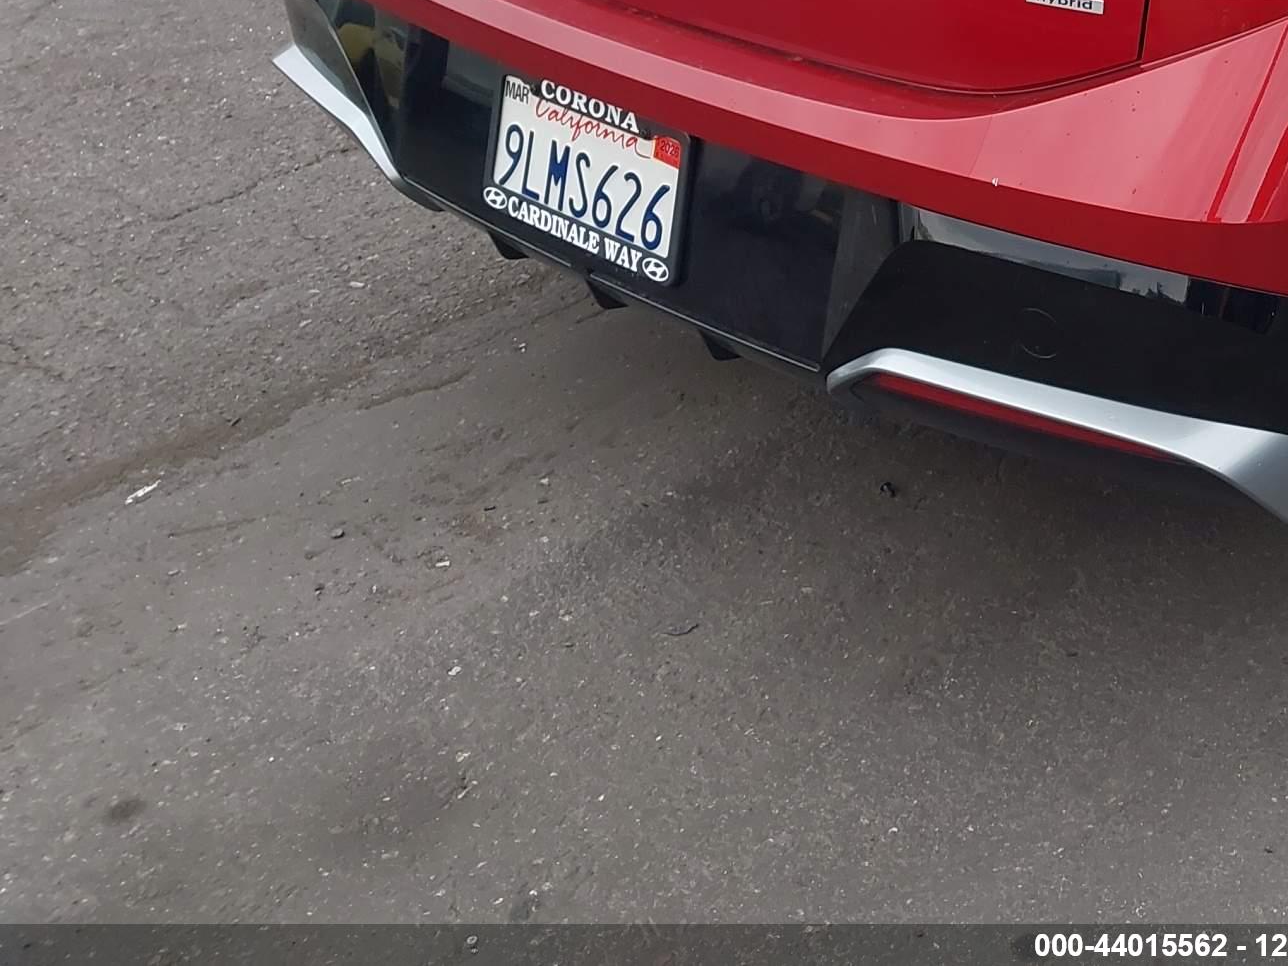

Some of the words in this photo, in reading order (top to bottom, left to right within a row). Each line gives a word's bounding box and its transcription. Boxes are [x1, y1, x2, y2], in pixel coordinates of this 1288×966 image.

[504, 80, 531, 105] MAR
[540, 78, 640, 134] CORONA
[535, 98, 651, 158] California
[498, 123, 671, 251] 9LMS626
[507, 196, 600, 254] CARDINALE
[604, 237, 643, 273] WAY
